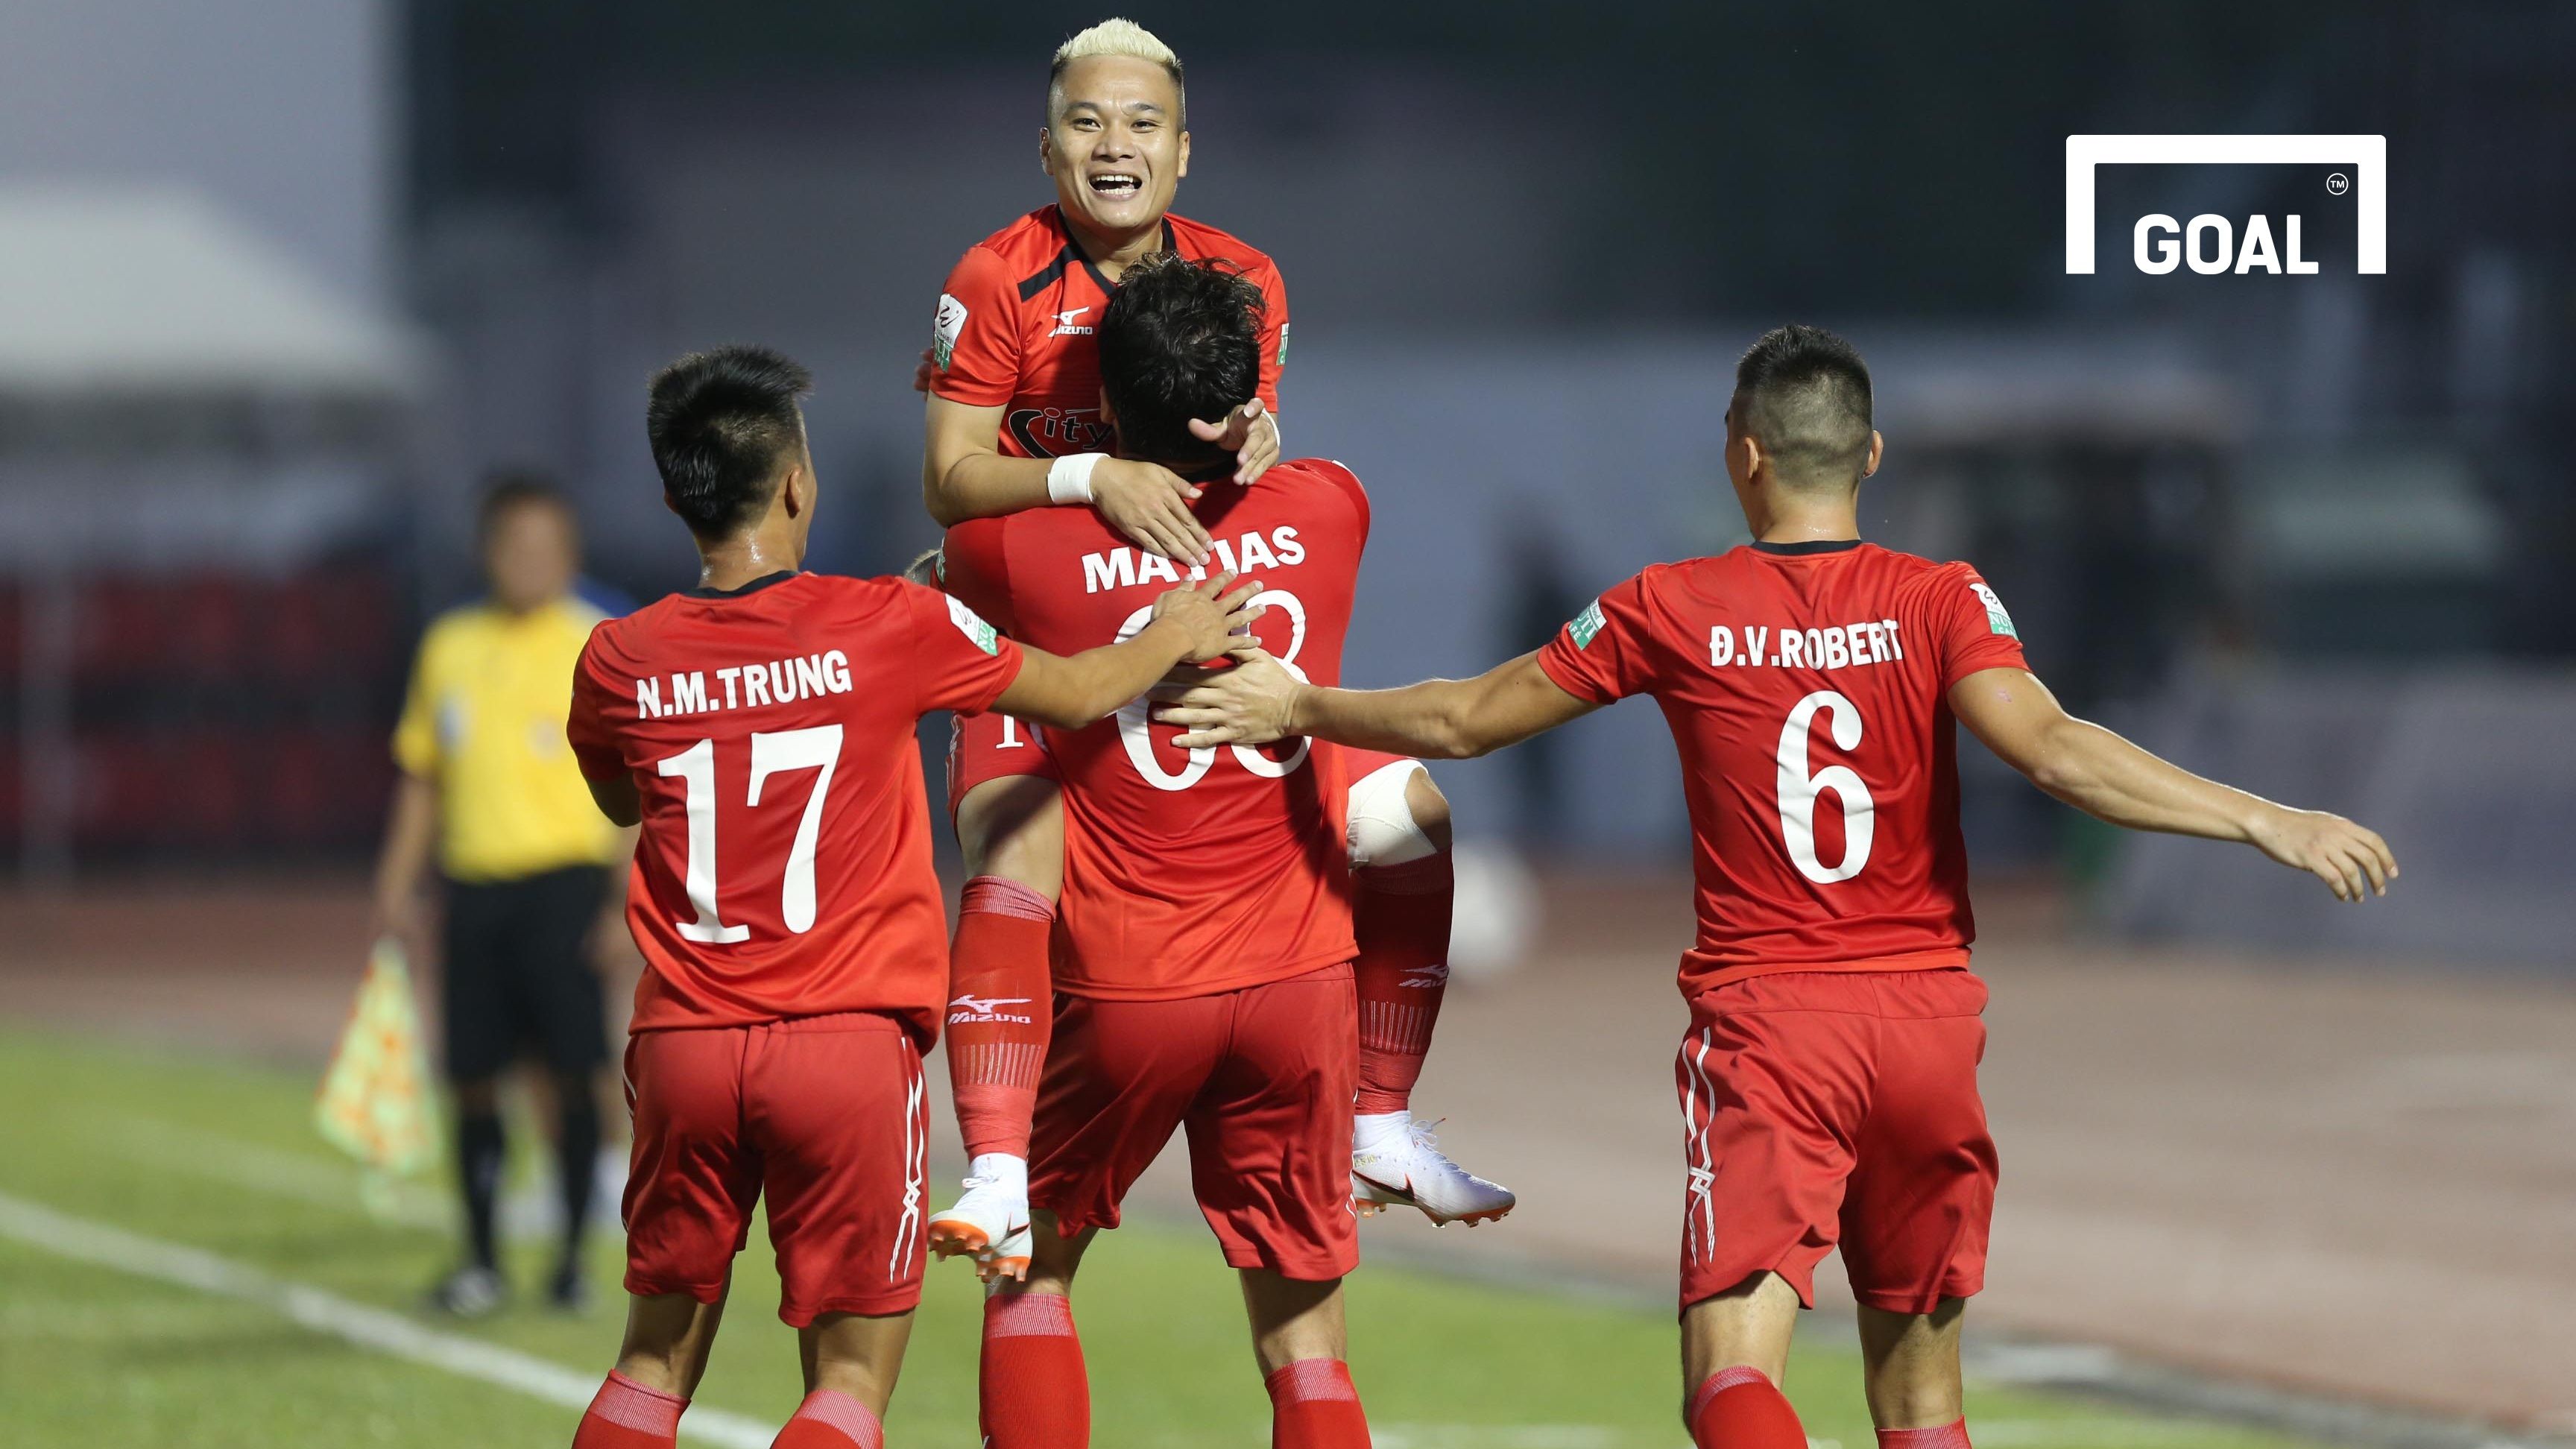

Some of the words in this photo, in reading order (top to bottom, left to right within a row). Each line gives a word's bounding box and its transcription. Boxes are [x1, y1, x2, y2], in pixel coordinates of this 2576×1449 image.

[637, 649, 853, 719] N.M.TRUNG
[1709, 619, 1904, 670] Đ.V.ROBERT
[657, 723, 844, 944] 17
[1776, 689, 1875, 885] 6
